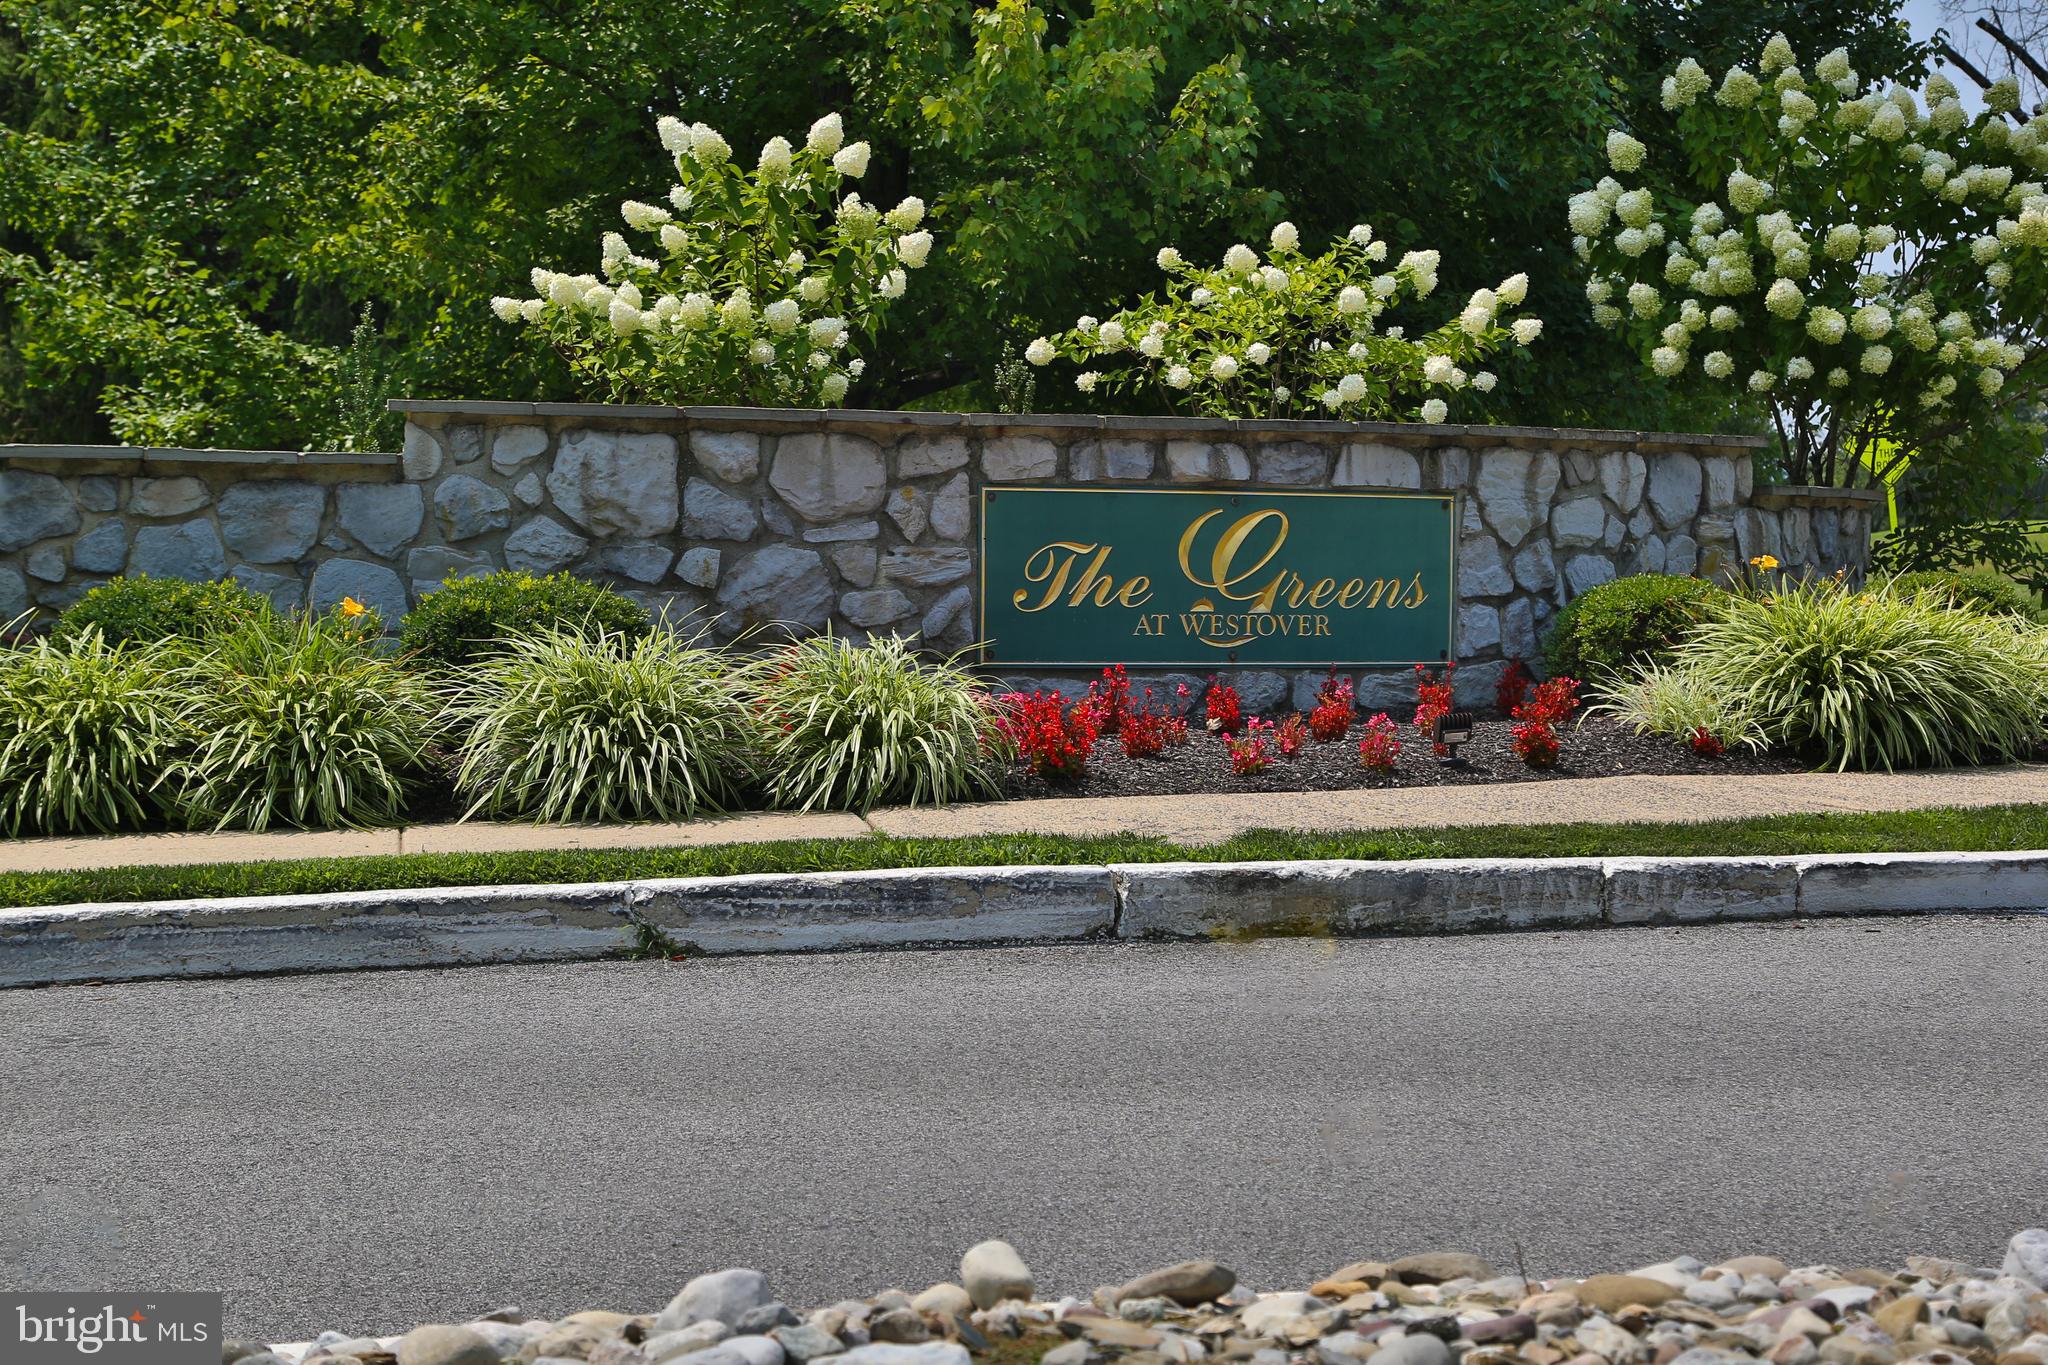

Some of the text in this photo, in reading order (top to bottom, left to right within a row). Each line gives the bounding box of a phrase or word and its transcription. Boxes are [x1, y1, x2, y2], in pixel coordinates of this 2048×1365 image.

[1013, 508, 1429, 613] The Greens
[1133, 614, 1332, 637] AT WESTOVER
